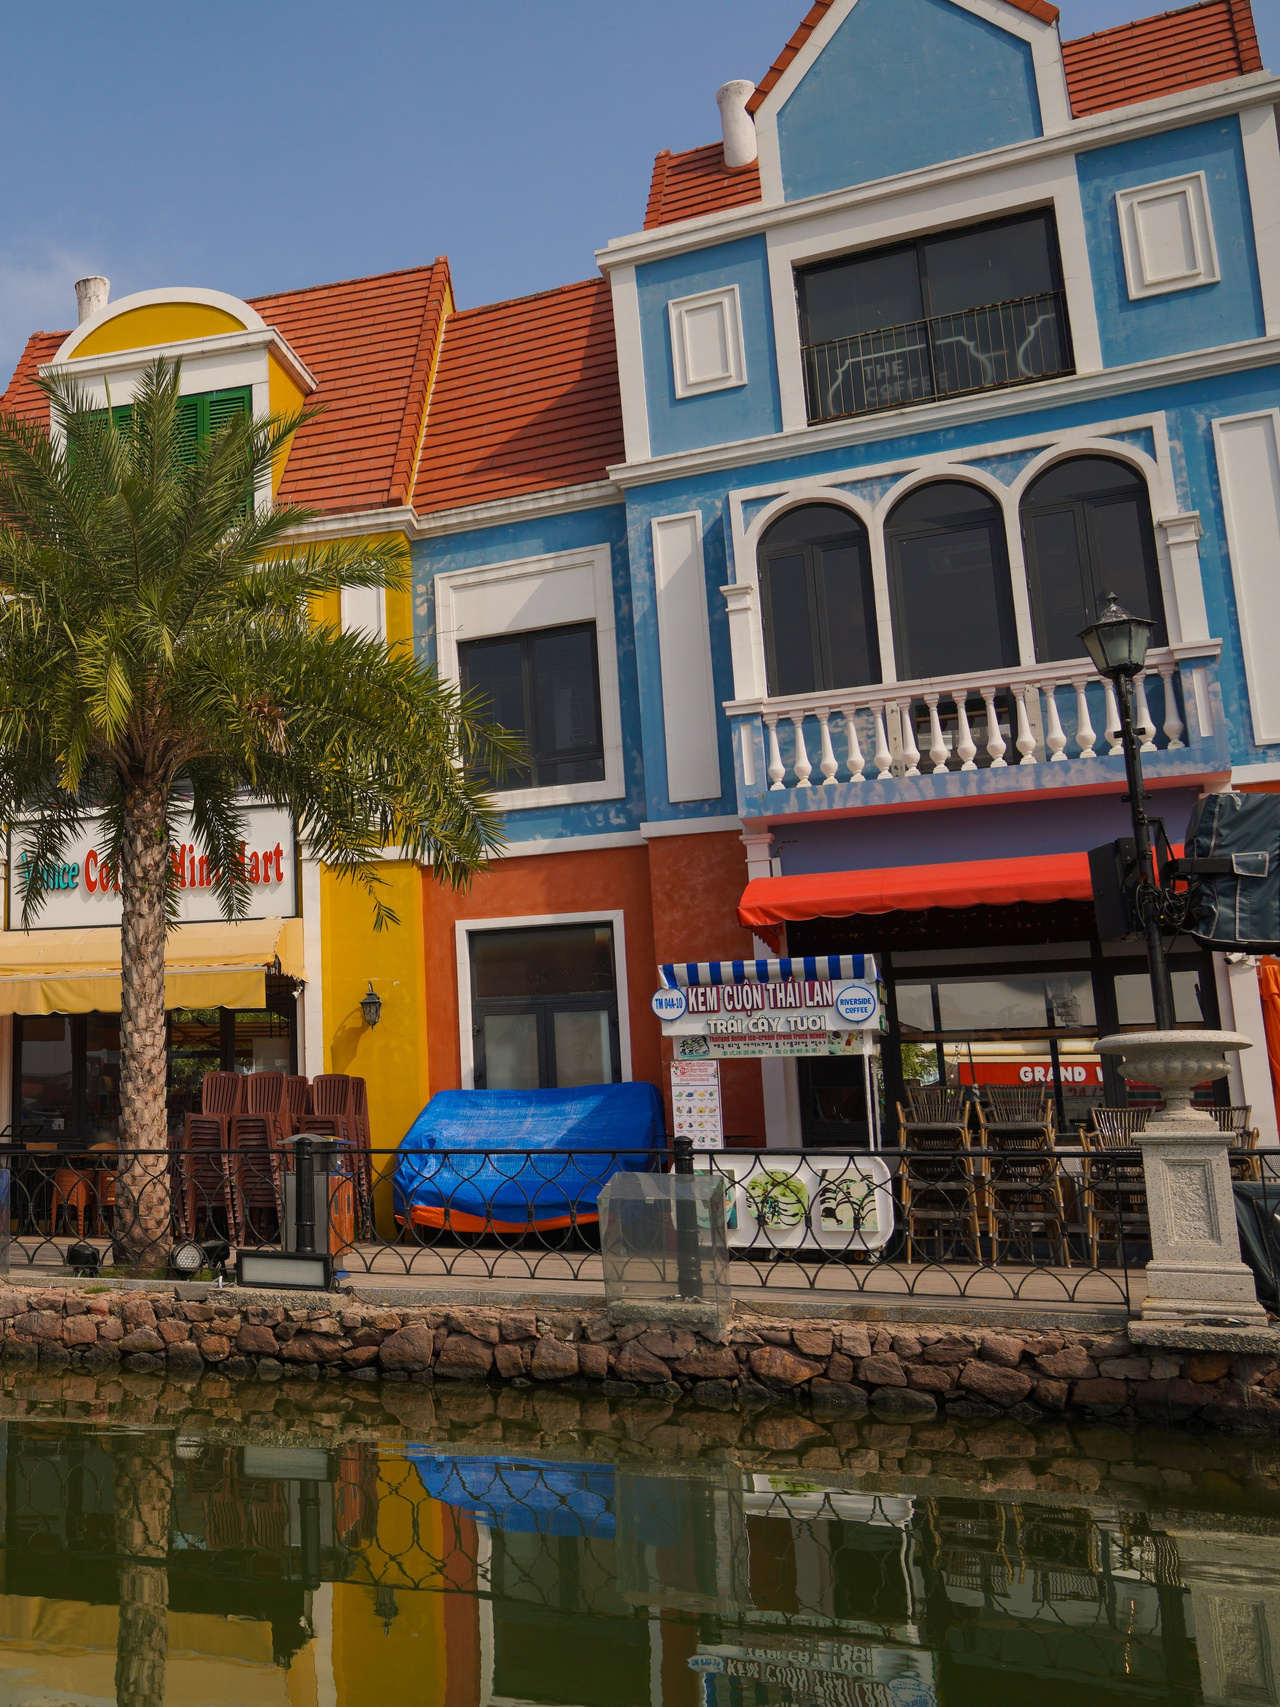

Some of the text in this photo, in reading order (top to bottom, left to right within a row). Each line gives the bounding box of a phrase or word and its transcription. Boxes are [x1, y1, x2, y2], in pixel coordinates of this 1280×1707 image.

[863, 359, 905, 381] THE
[170, 843, 220, 889] Min
[654, 997, 683, 1010] TM 04A-10
[687, 976, 833, 1016] KEM CUỘN THÁI LAN
[839, 997, 872, 1006] RIVERSIDE
[845, 1006, 869, 1014] COFFEE
[707, 1014, 826, 1035] TRÁI CÂY TƯƠI
[709, 1035, 728, 1043] Thailand
